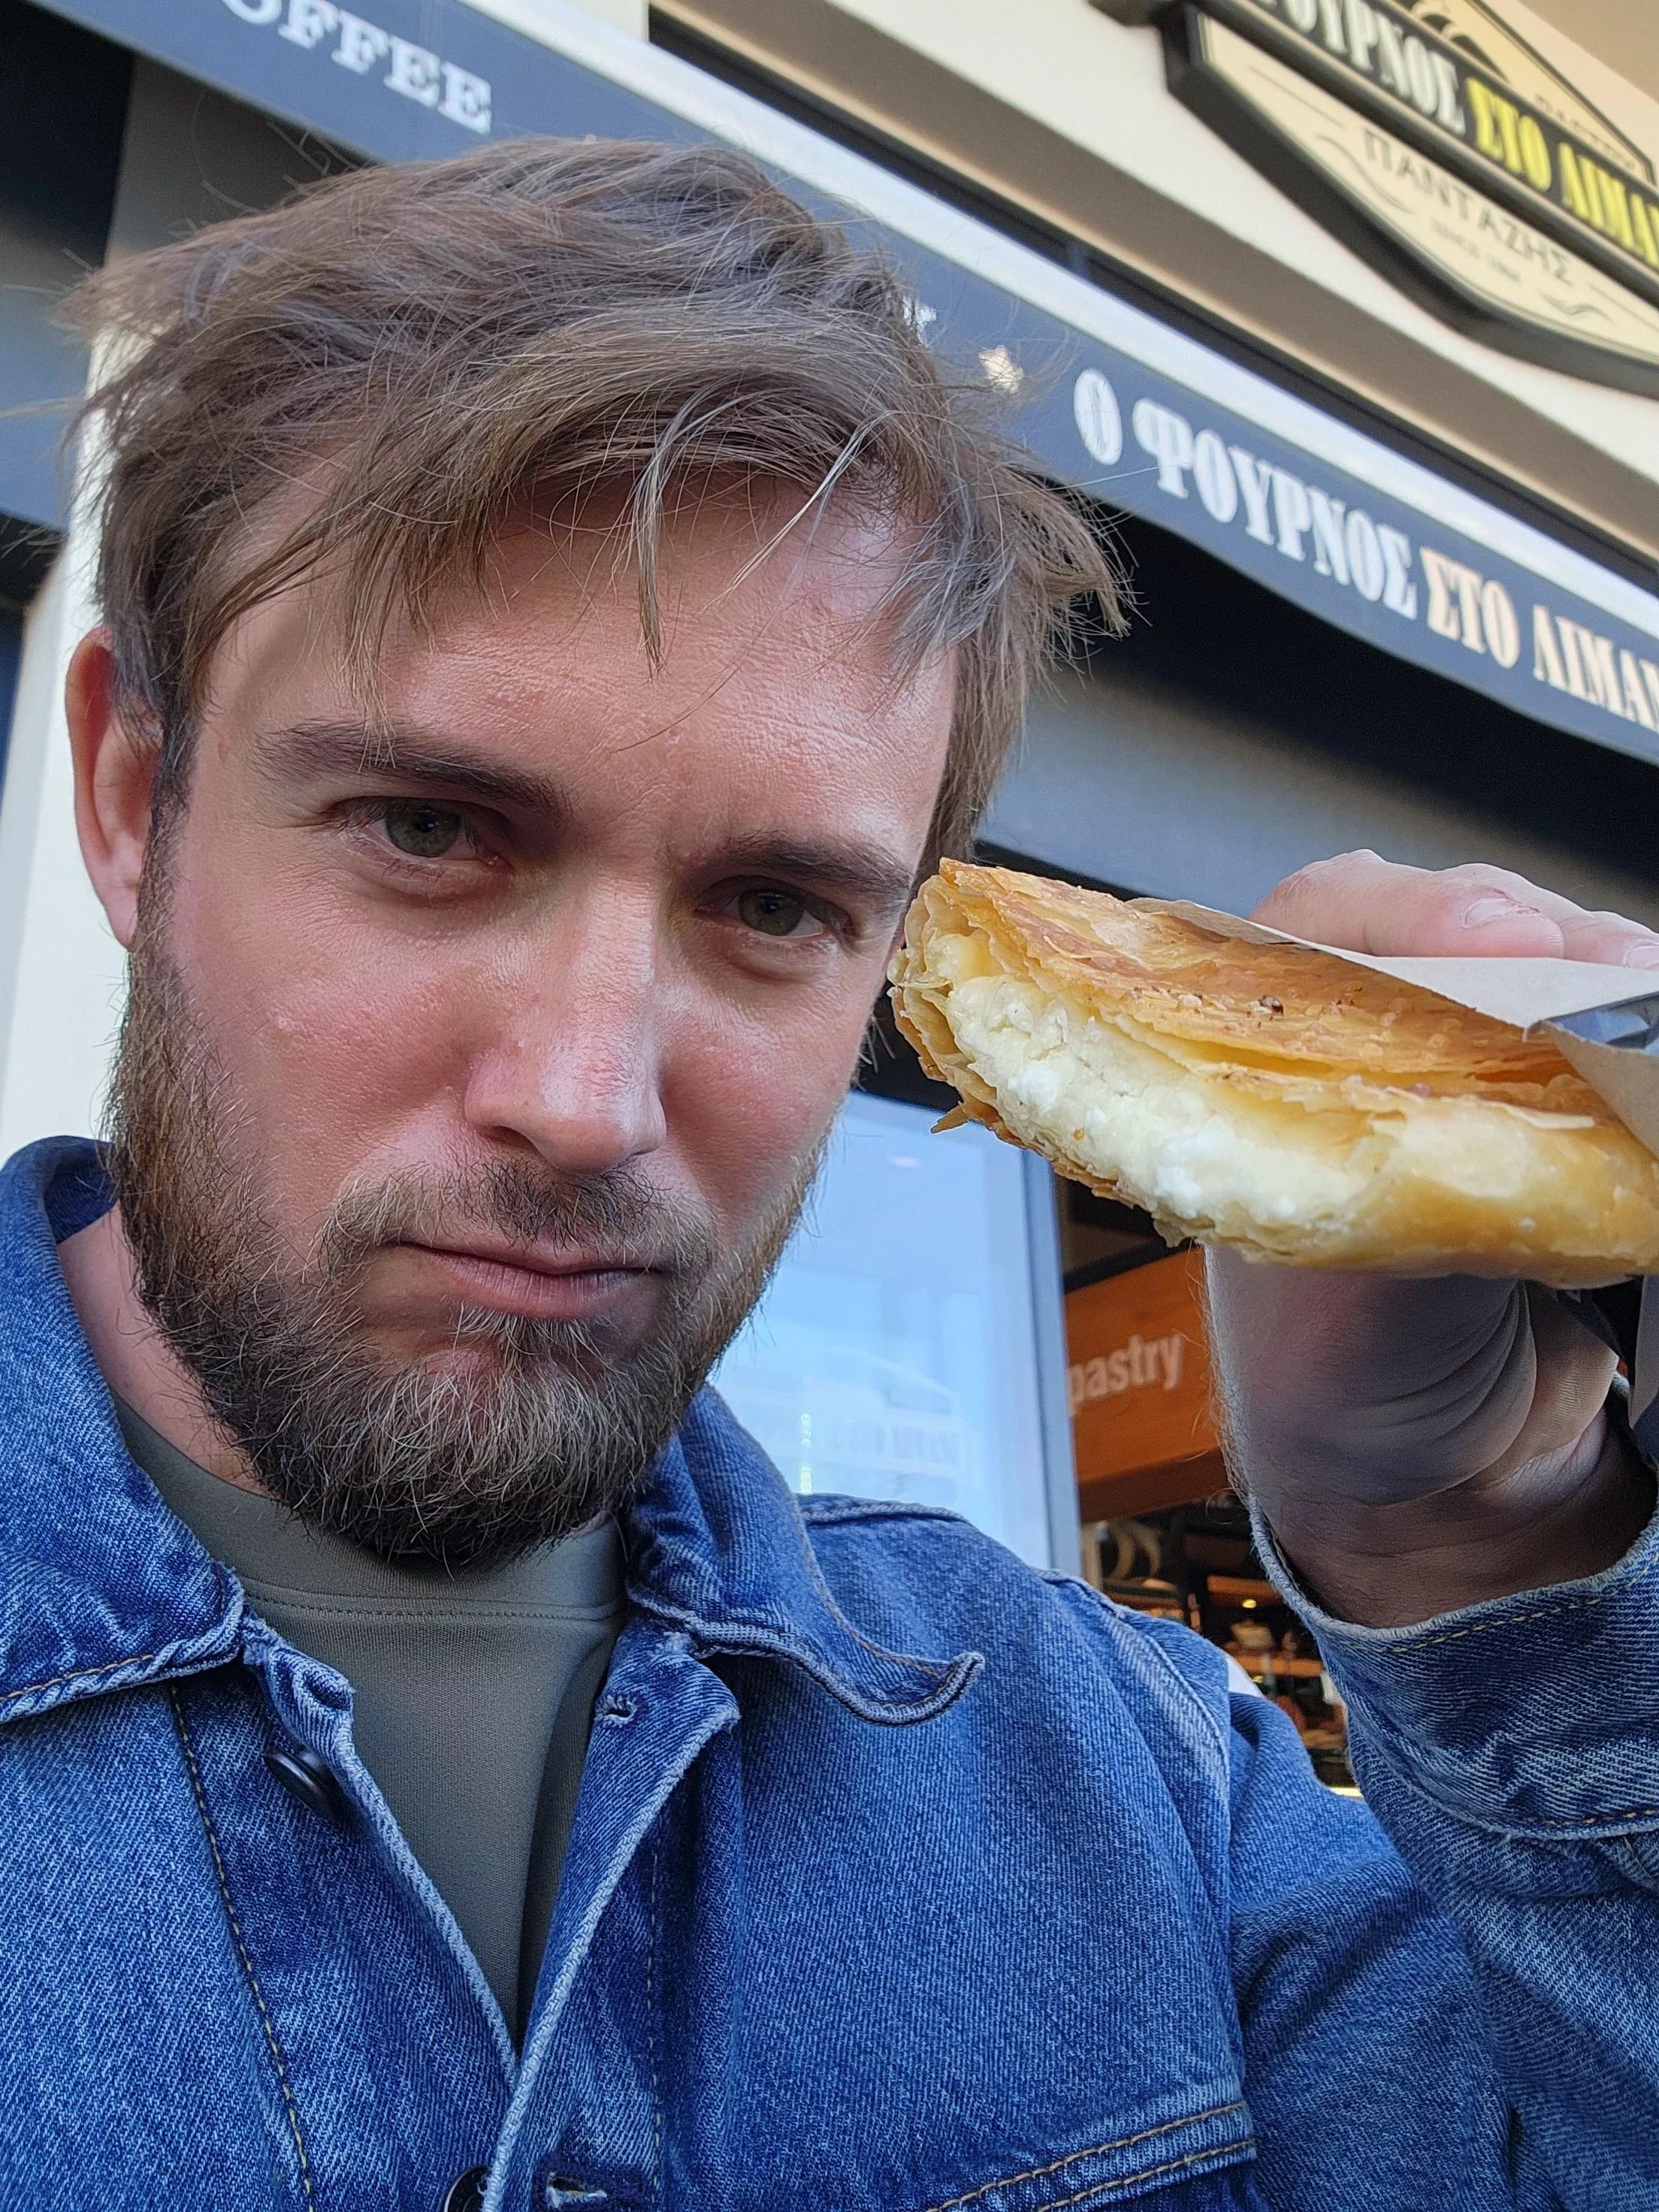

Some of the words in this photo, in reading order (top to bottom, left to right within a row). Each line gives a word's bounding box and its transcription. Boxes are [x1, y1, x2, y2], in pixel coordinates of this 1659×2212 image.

[1262, 0, 1465, 135] ΥΡΝΟΣ
[1363, 125, 1574, 288] ΠΑΝΤΑΖΗΣ
[1074, 369, 1123, 466] Ο
[1132, 398, 1417, 620] ΦΟΥΡΝΟΣ
[1419, 546, 1521, 669] ΣΤΟ
[1068, 1332, 1183, 1419] pastry
